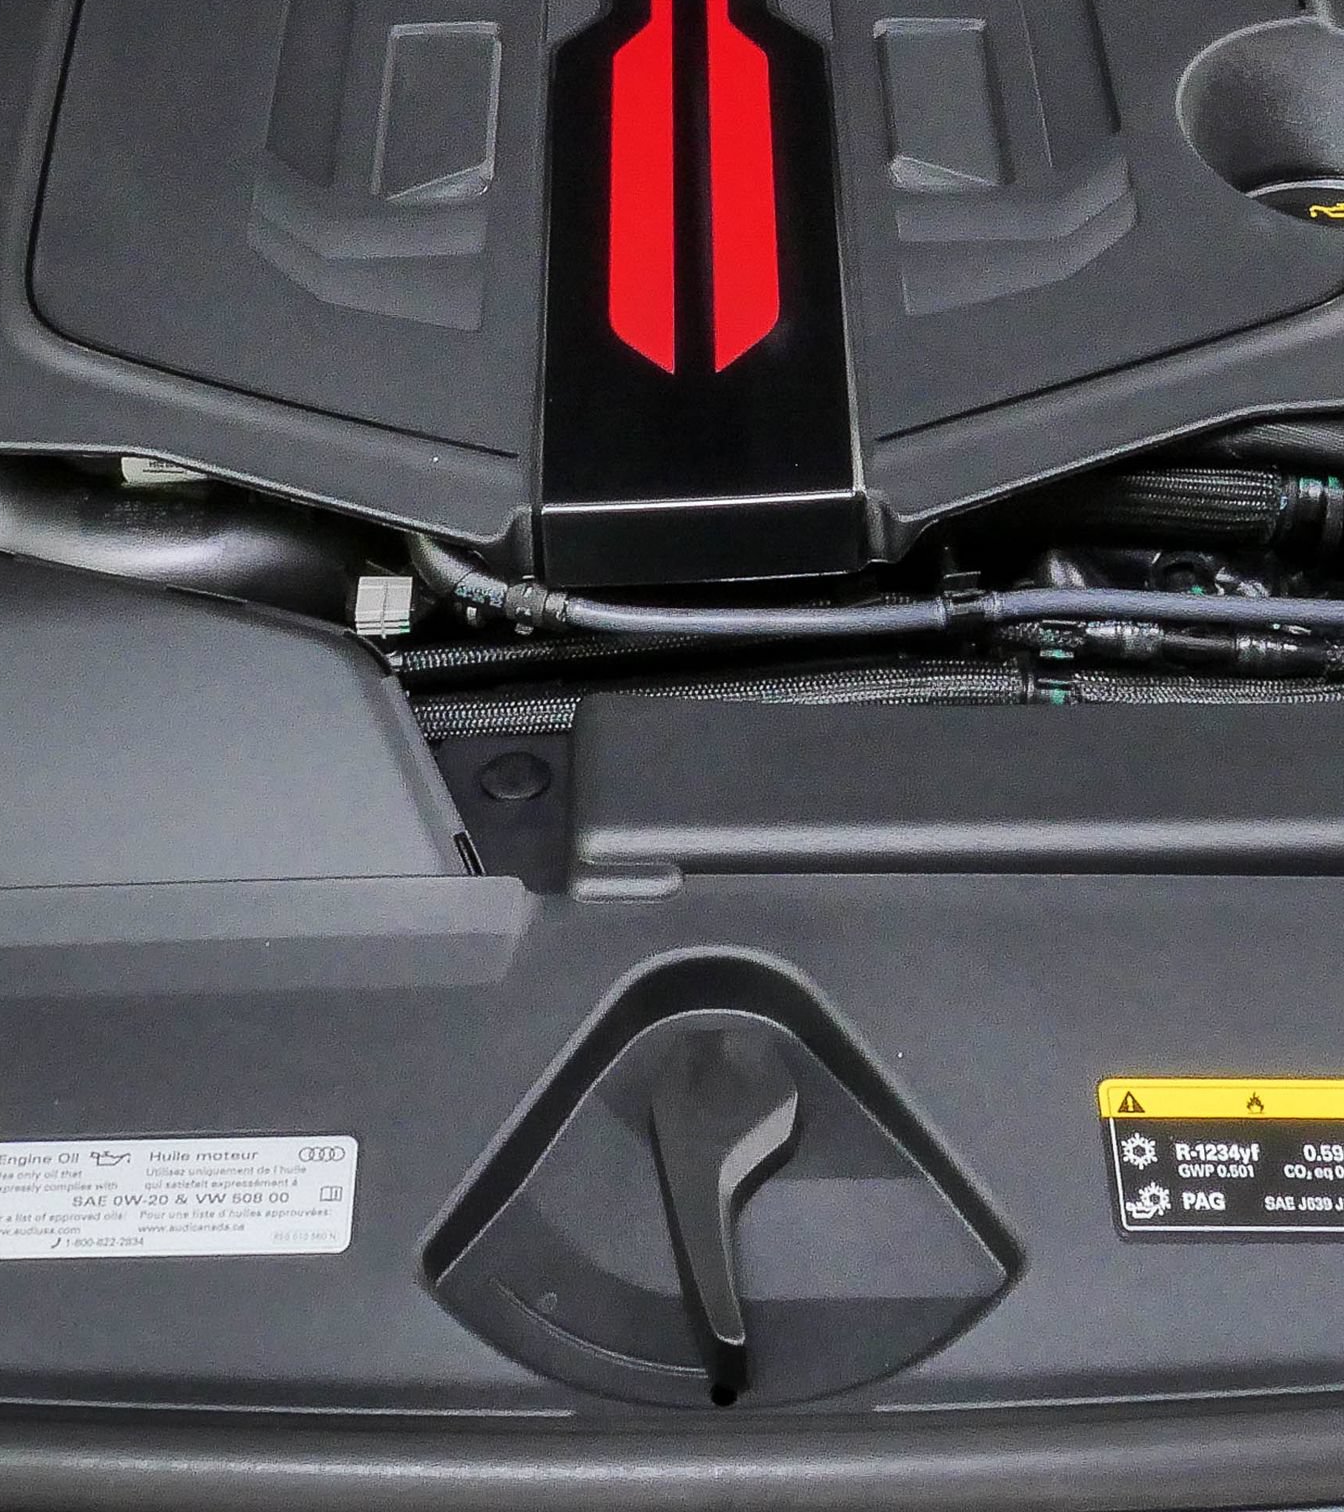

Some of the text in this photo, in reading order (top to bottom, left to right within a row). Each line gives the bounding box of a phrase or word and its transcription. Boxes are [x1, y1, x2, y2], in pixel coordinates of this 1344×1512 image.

[58, 1152, 80, 1164] Oil
[150, 1152, 258, 1162] Huile moteur
[1175, 1143, 1261, 1164] R-1234yf
[17, 1170, 42, 1180] only
[44, 1170, 57, 1178] oil
[60, 1170, 82, 1178] that
[146, 1167, 184, 1176] Utilisez
[188, 1166, 254, 1178] uniquement
[256, 1166, 270, 1174] de
[1178, 1164, 1215, 1178] GWP
[1314, 1167, 1334, 1181] eq
[44, 1183, 92, 1193] complies
[96, 1182, 118, 1190] with
[144, 1180, 162, 1190] qui
[72, 1192, 290, 1207] SAE 0W-20 & VW 508 00
[1182, 1191, 1226, 1210] PAG
[1264, 1196, 1296, 1211] SAE
[16, 1213, 32, 1222] list
[34, 1212, 46, 1222] of
[48, 1212, 101, 1224] approved
[140, 1210, 165, 1220] Pour
[168, 1211, 189, 1219] une
[192, 1210, 216, 1218] liste
[138, 1223, 245, 1233] www.audicanada.ca
